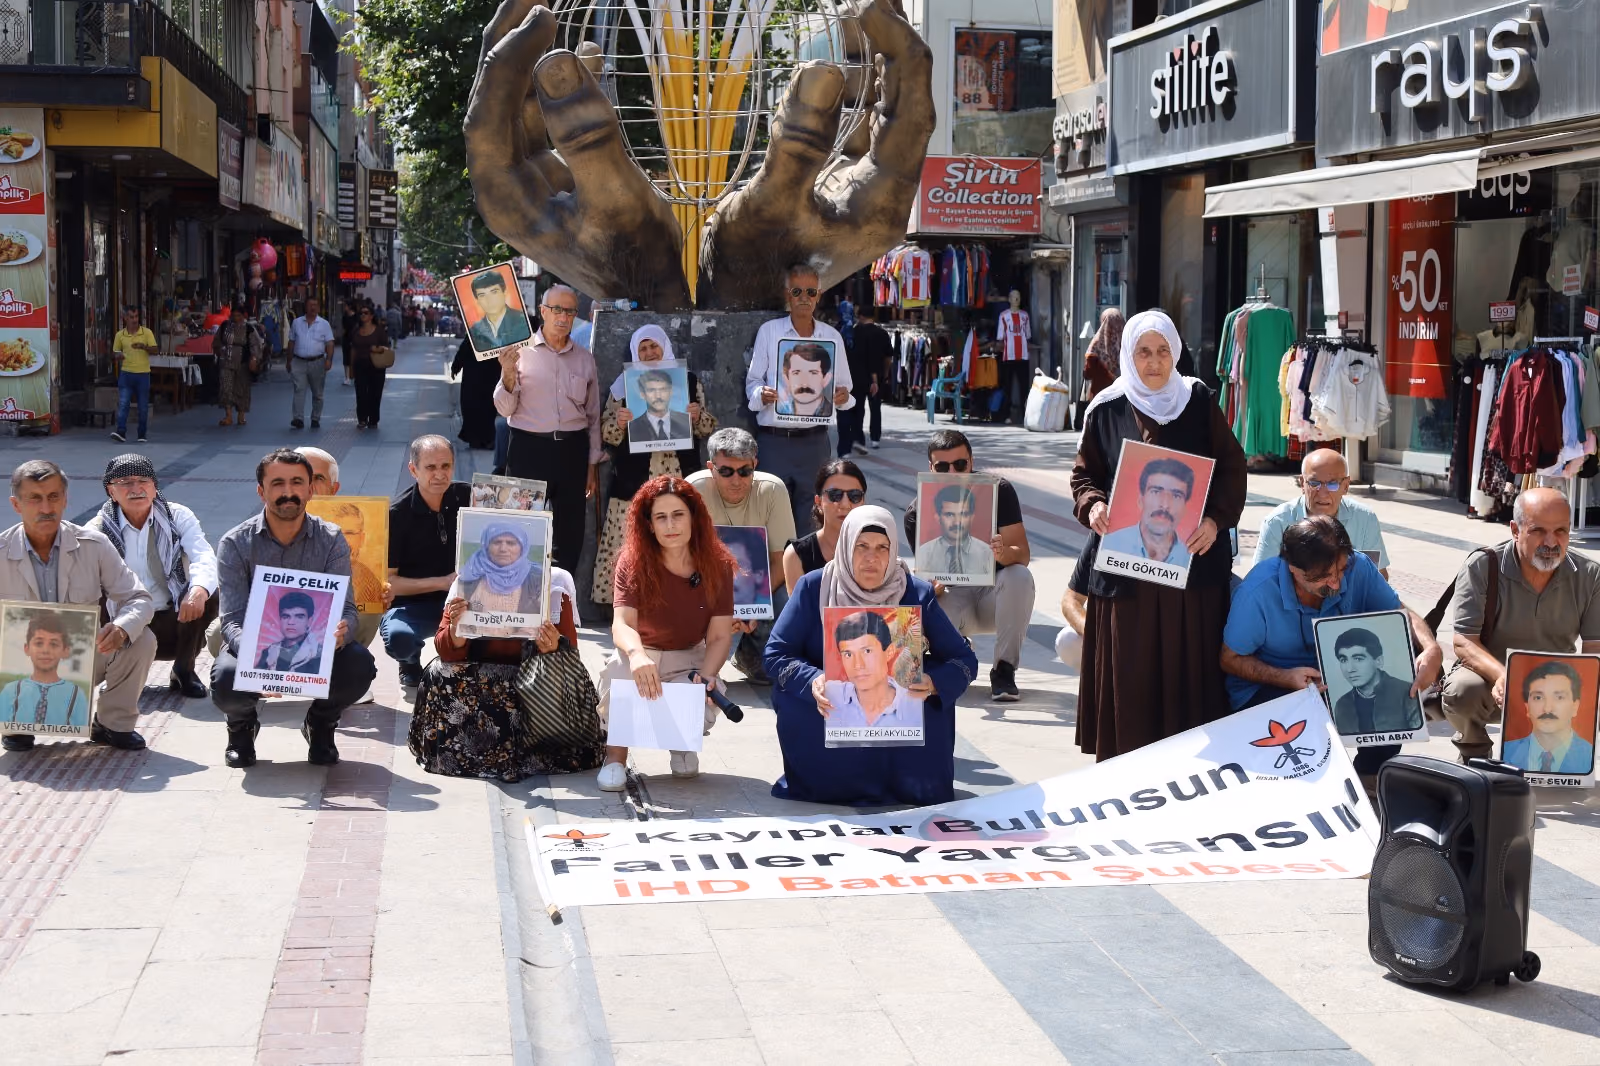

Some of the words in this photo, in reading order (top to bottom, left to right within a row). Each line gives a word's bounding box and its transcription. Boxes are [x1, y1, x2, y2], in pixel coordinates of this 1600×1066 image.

[1150, 26, 1231, 119] stilife
[944, 162, 1019, 189] Şirin
[927, 187, 1033, 205] Collection
[1492, 307, 1508, 317] 199
[1399, 318, 1438, 339] İNDİRİM
[1106, 556, 1129, 570] Eset
[1132, 562, 1179, 581] GÖKTAYI
[263, 573, 295, 584] EDİP
[298, 578, 340, 590] ÇELİK
[505, 614, 525, 623] Ana
[740, 607, 767, 615] SEVİM
[239, 671, 284, 682] 10/07/1993'DE
[285, 674, 328, 685] GÖZALTINDA
[262, 684, 302, 694] KAYBEDİLDİ
[4, 722, 37, 732] VEYSEL
[39, 724, 81, 734] ATILGAN
[864, 729, 883, 737] ZEKİ
[884, 729, 921, 737] AKYILDIZ
[1356, 734, 1385, 744] ÇETİN
[1387, 732, 1414, 742] ABAY
[1524, 777, 1544, 785] ZET
[1547, 778, 1581, 786] SEVEN
[635, 823, 912, 843] Kayıplar
[933, 763, 1249, 833] Bulunsun
[551, 852, 844, 876] Failler
[778, 870, 1072, 892] Batman
[1093, 859, 1350, 883] Şubesi
